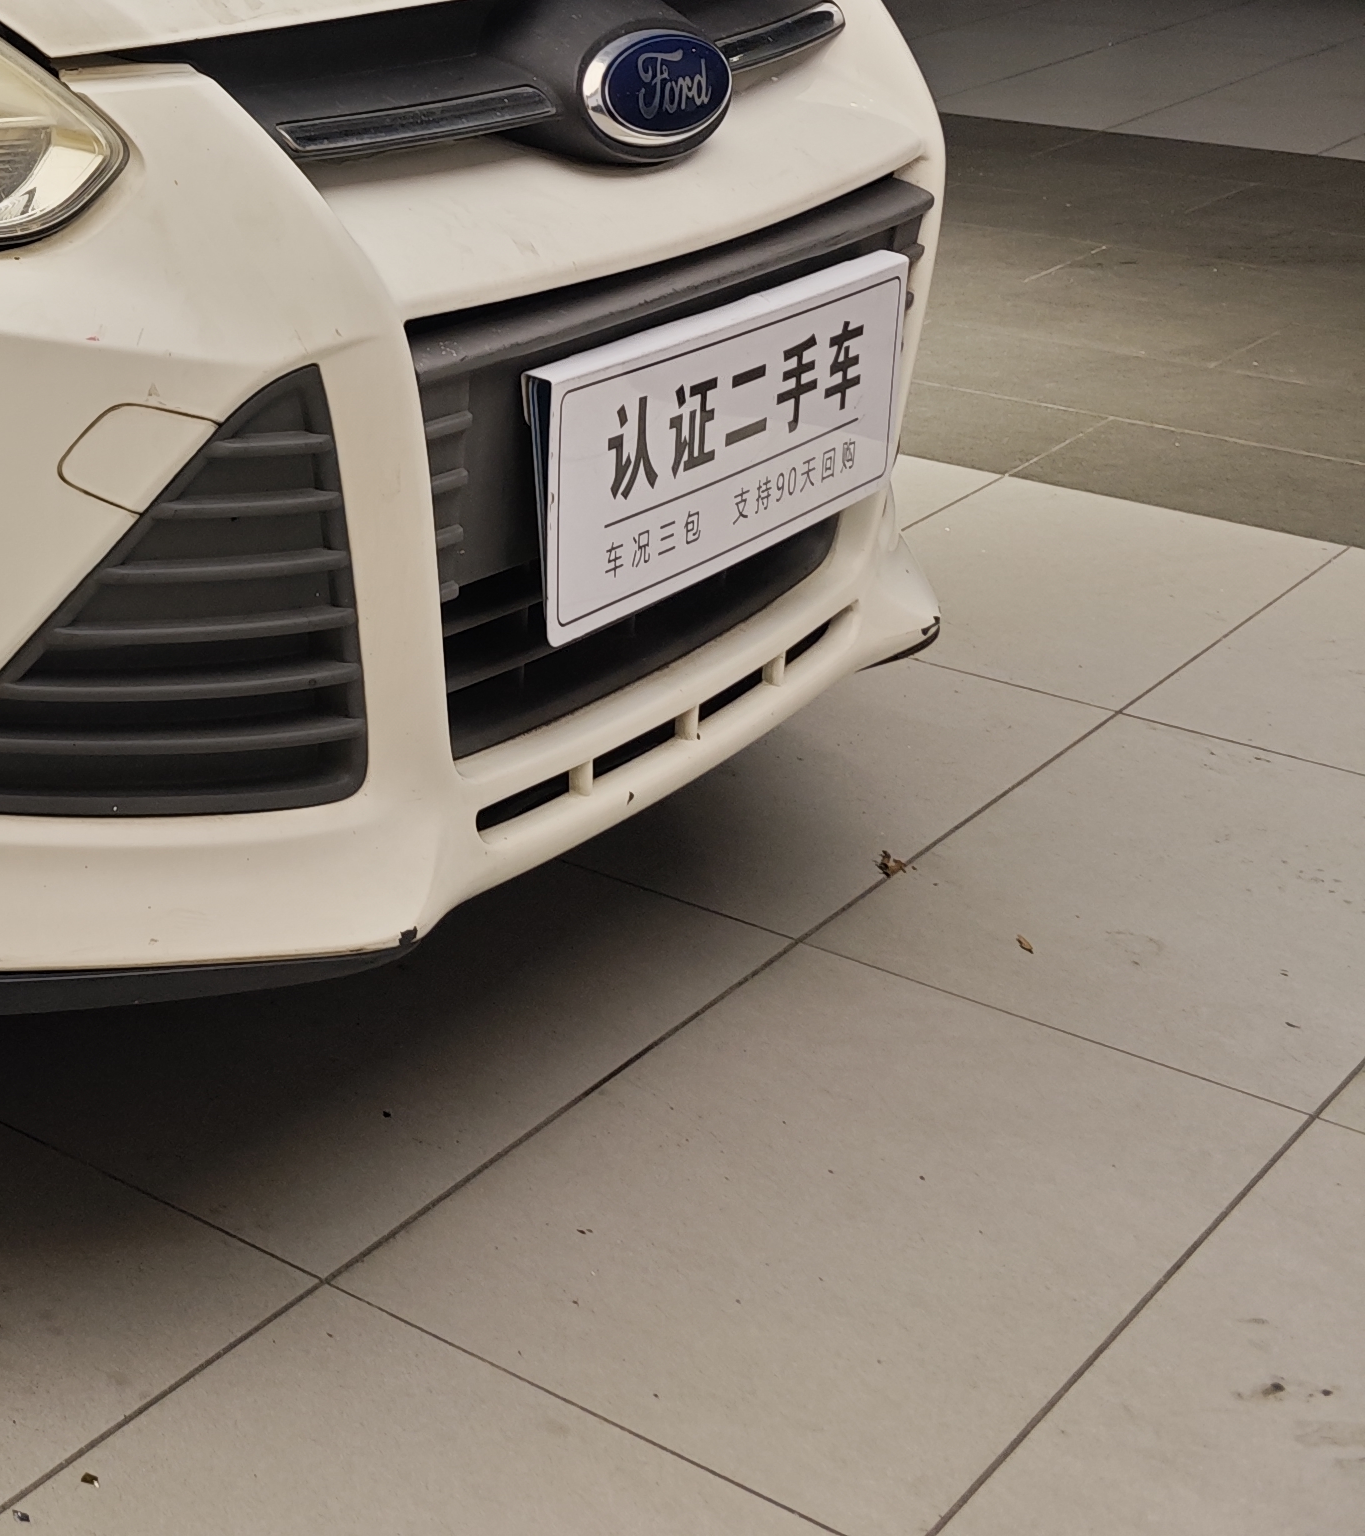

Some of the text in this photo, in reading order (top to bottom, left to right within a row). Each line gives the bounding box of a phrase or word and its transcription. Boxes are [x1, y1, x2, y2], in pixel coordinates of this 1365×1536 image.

[637, 48, 712, 120] Ford
[607, 320, 865, 501] 认证二手车
[604, 437, 857, 579] 车况三包 支持90天回购
